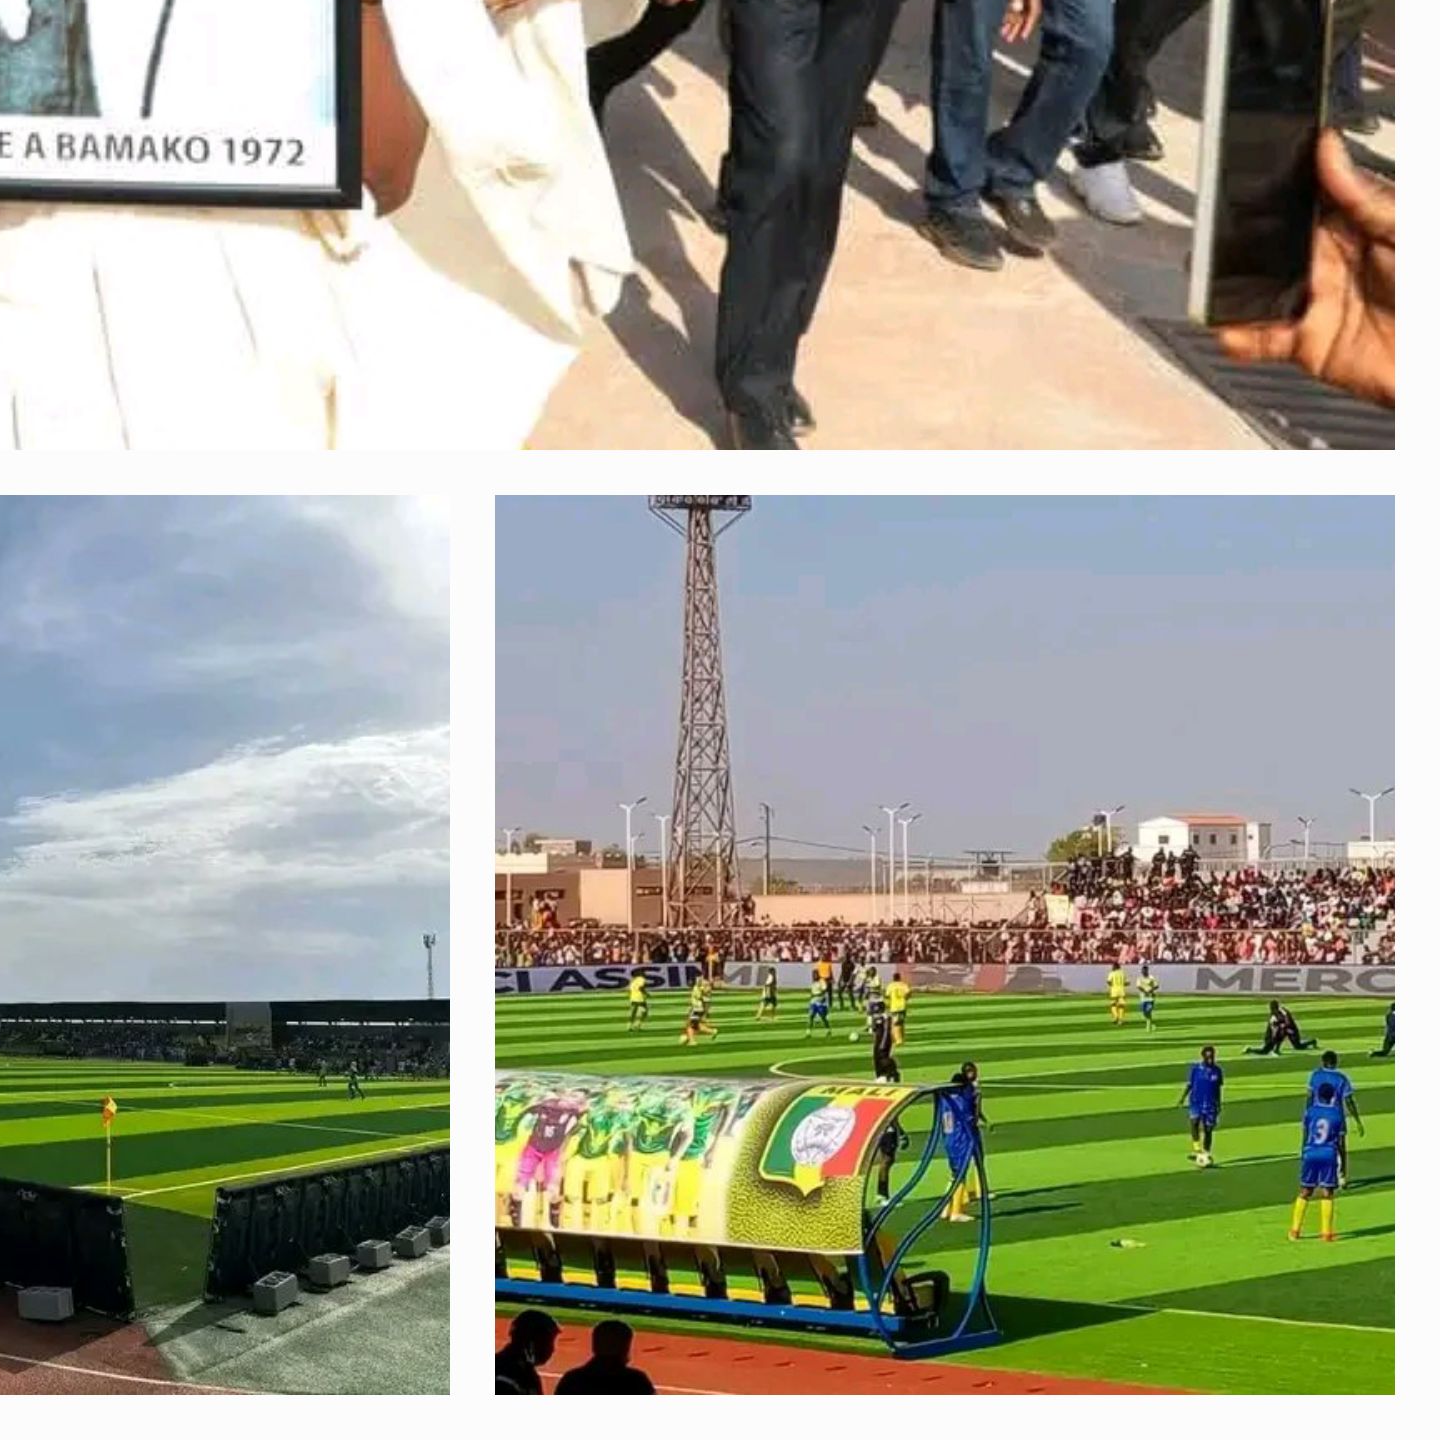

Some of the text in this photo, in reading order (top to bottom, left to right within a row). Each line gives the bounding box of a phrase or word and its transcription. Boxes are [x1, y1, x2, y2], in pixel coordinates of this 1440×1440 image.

[24, 132, 45, 160] A
[56, 132, 210, 164] BAMAKO
[223, 137, 306, 167] 1972
[1195, 967, 1395, 993] MERC
[1314, 1118, 1331, 1146] 3
